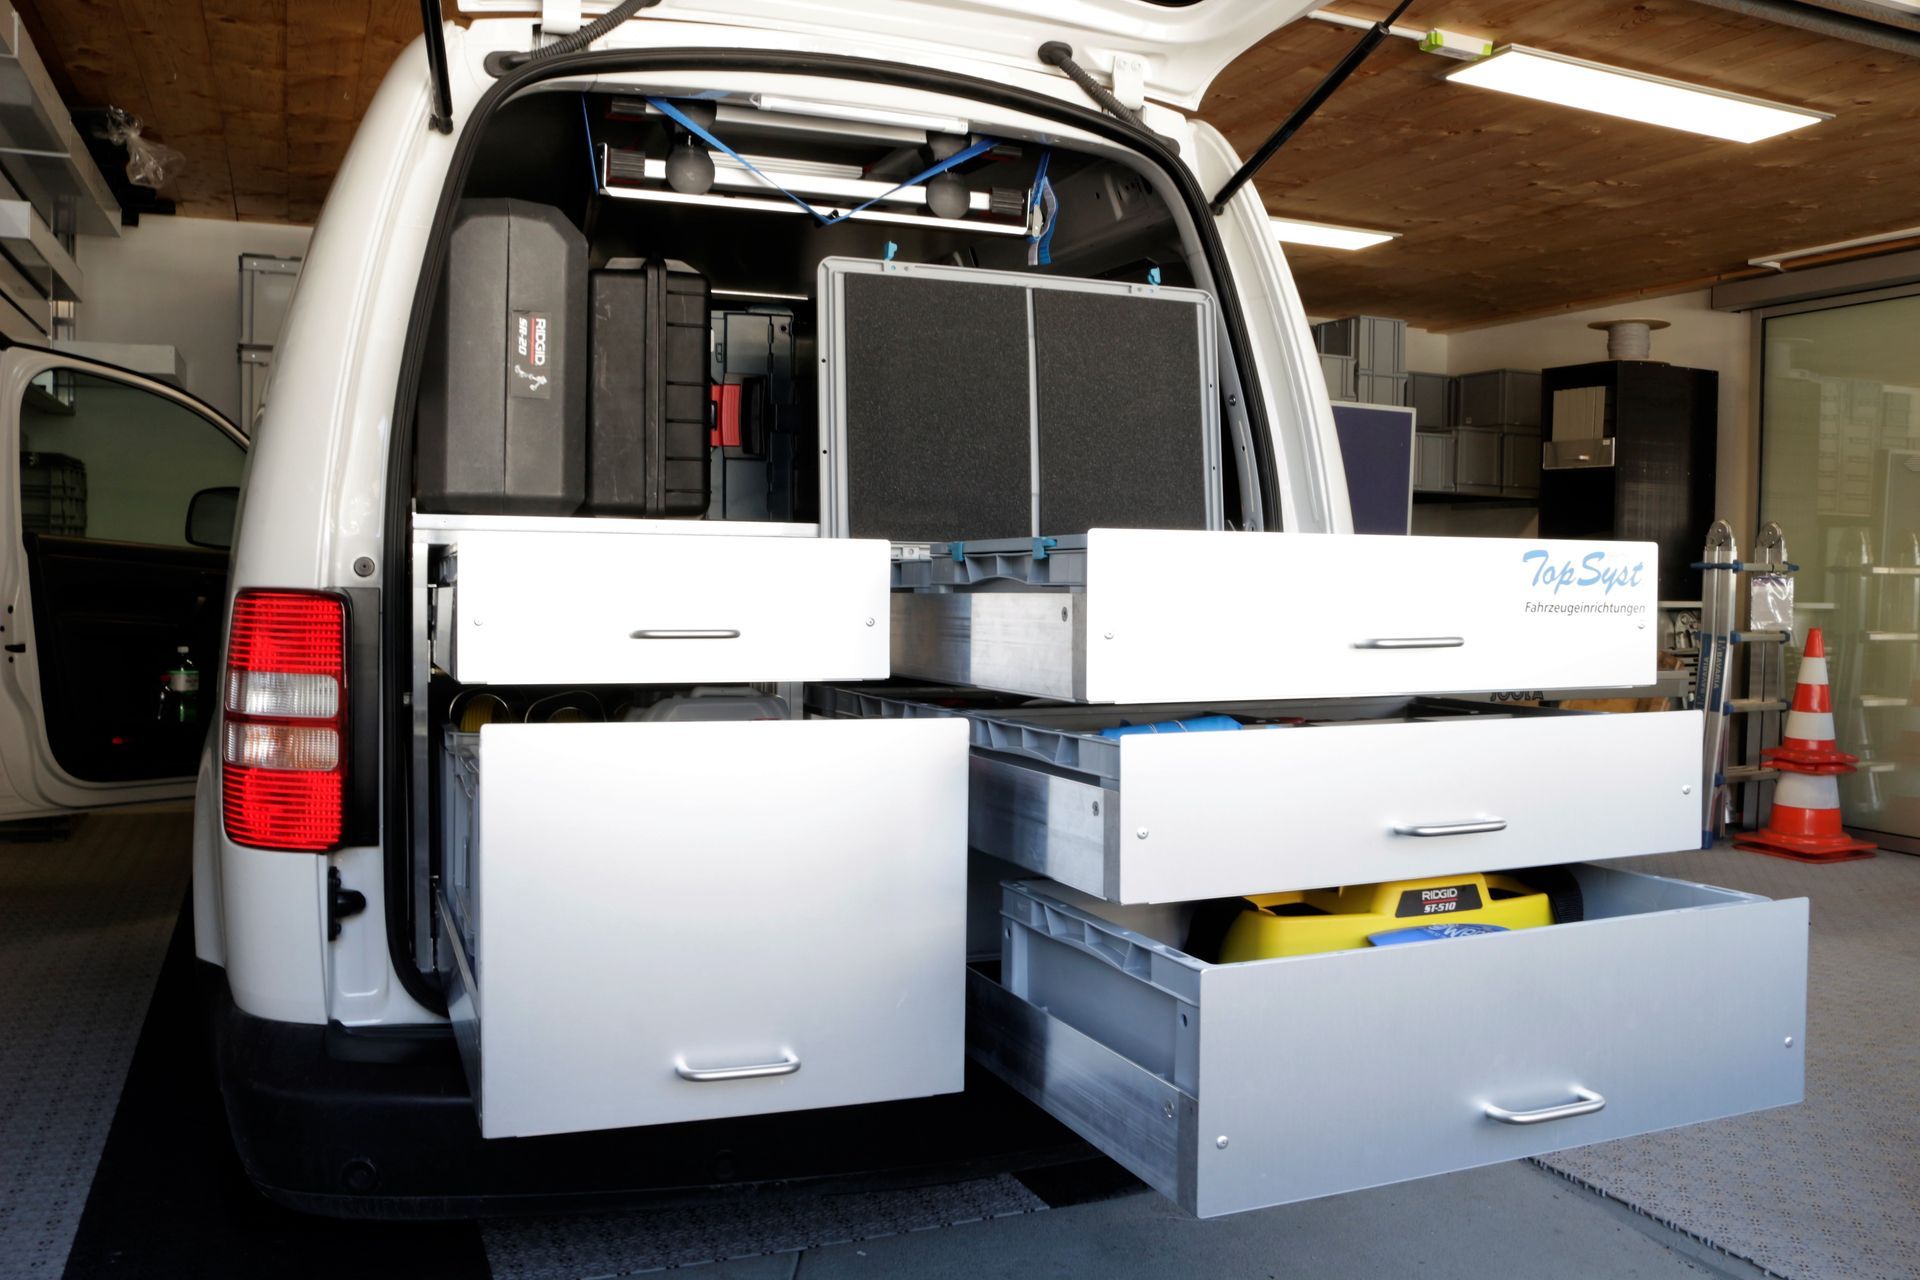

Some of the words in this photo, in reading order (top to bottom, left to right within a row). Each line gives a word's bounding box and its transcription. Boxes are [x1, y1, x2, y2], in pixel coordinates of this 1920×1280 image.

[518, 316, 528, 356] SR-20
[534, 317, 547, 366] RIDGID
[1522, 549, 1644, 595] TopSyst
[1524, 601, 1646, 617] Fahrzeugeinrichtungen
[1421, 887, 1458, 901] RIDGID
[1423, 901, 1457, 913] ST-510
